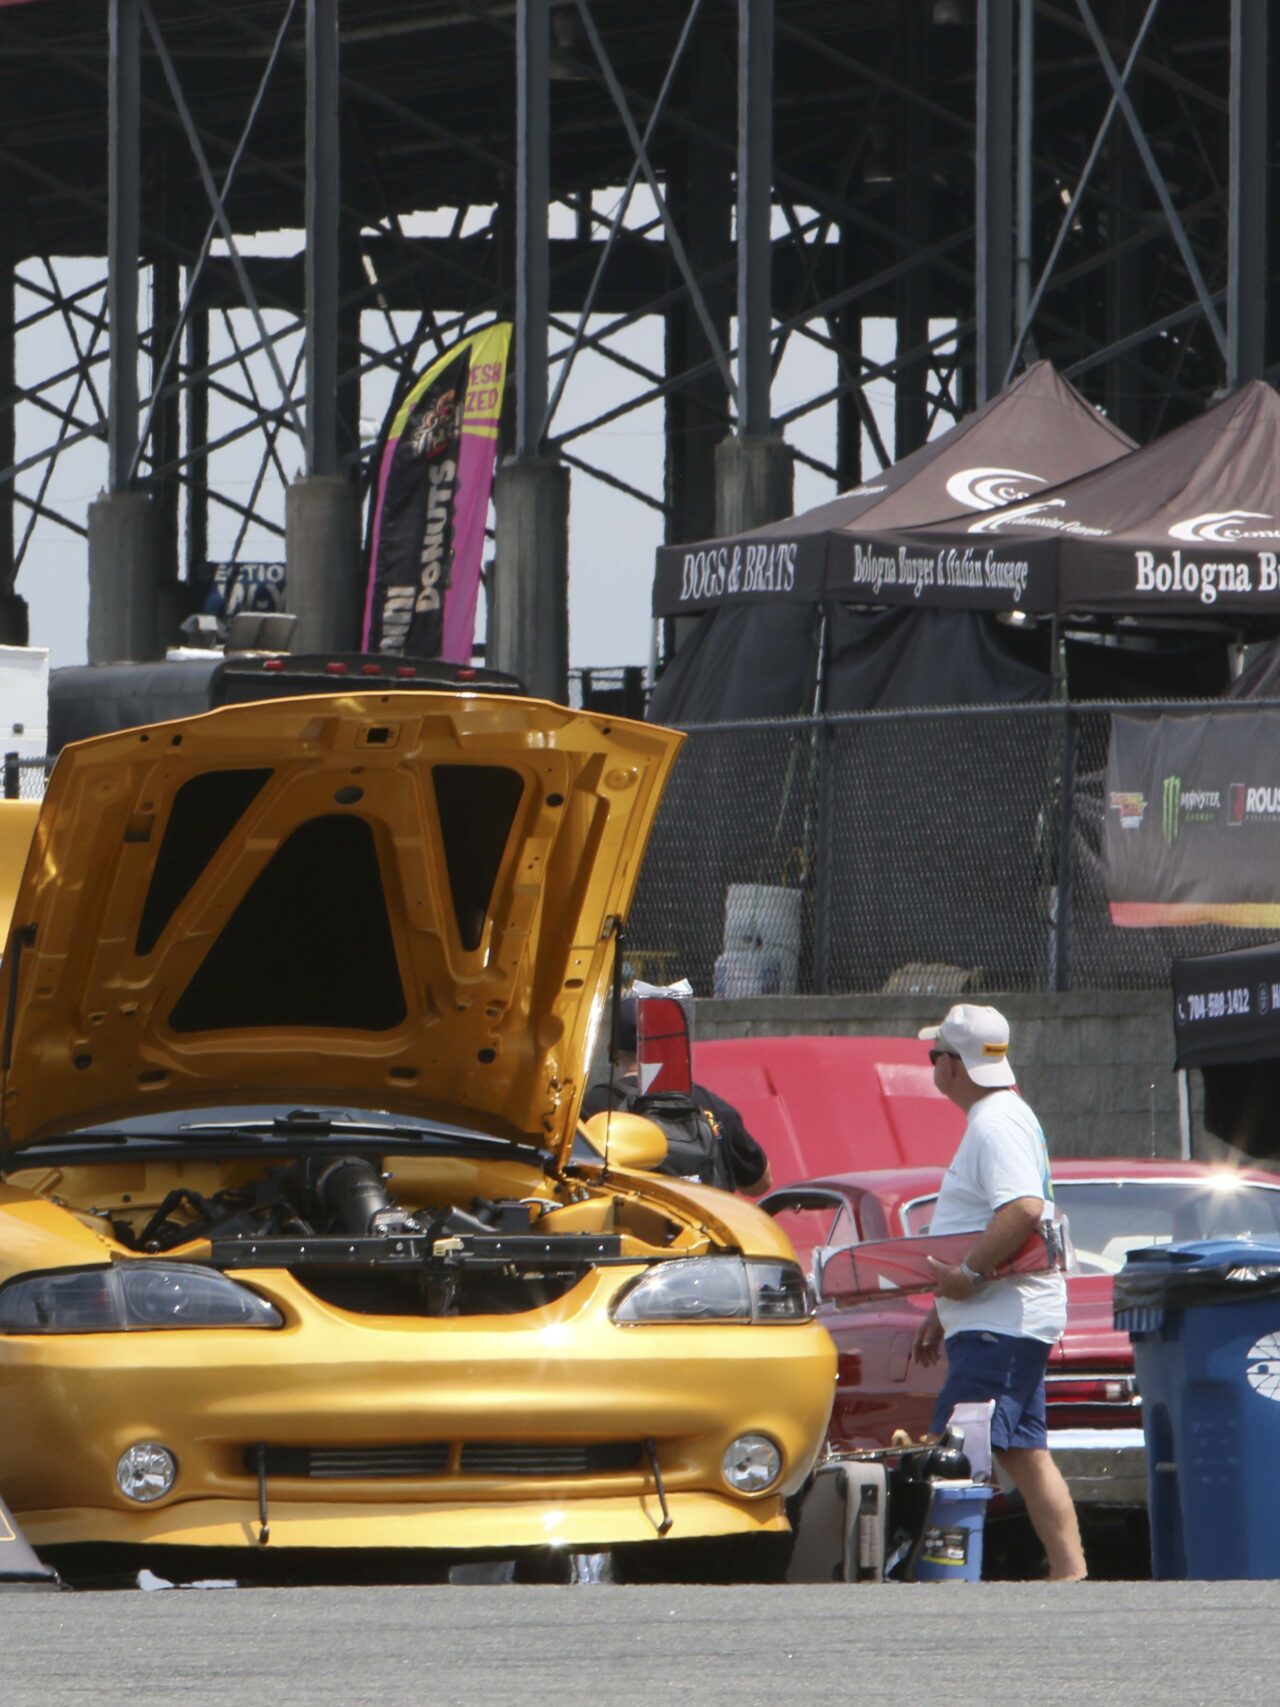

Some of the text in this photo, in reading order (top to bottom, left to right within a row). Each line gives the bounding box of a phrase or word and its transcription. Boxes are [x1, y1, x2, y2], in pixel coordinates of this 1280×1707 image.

[416, 458, 456, 613] DONUTS
[680, 543, 797, 600] DOGS & BRATS
[853, 544, 897, 594] Bologna
[898, 546, 934, 598] Burger
[946, 548, 983, 587] Italian
[985, 550, 1028, 602] Sausage
[1135, 550, 1252, 604] Bologna
